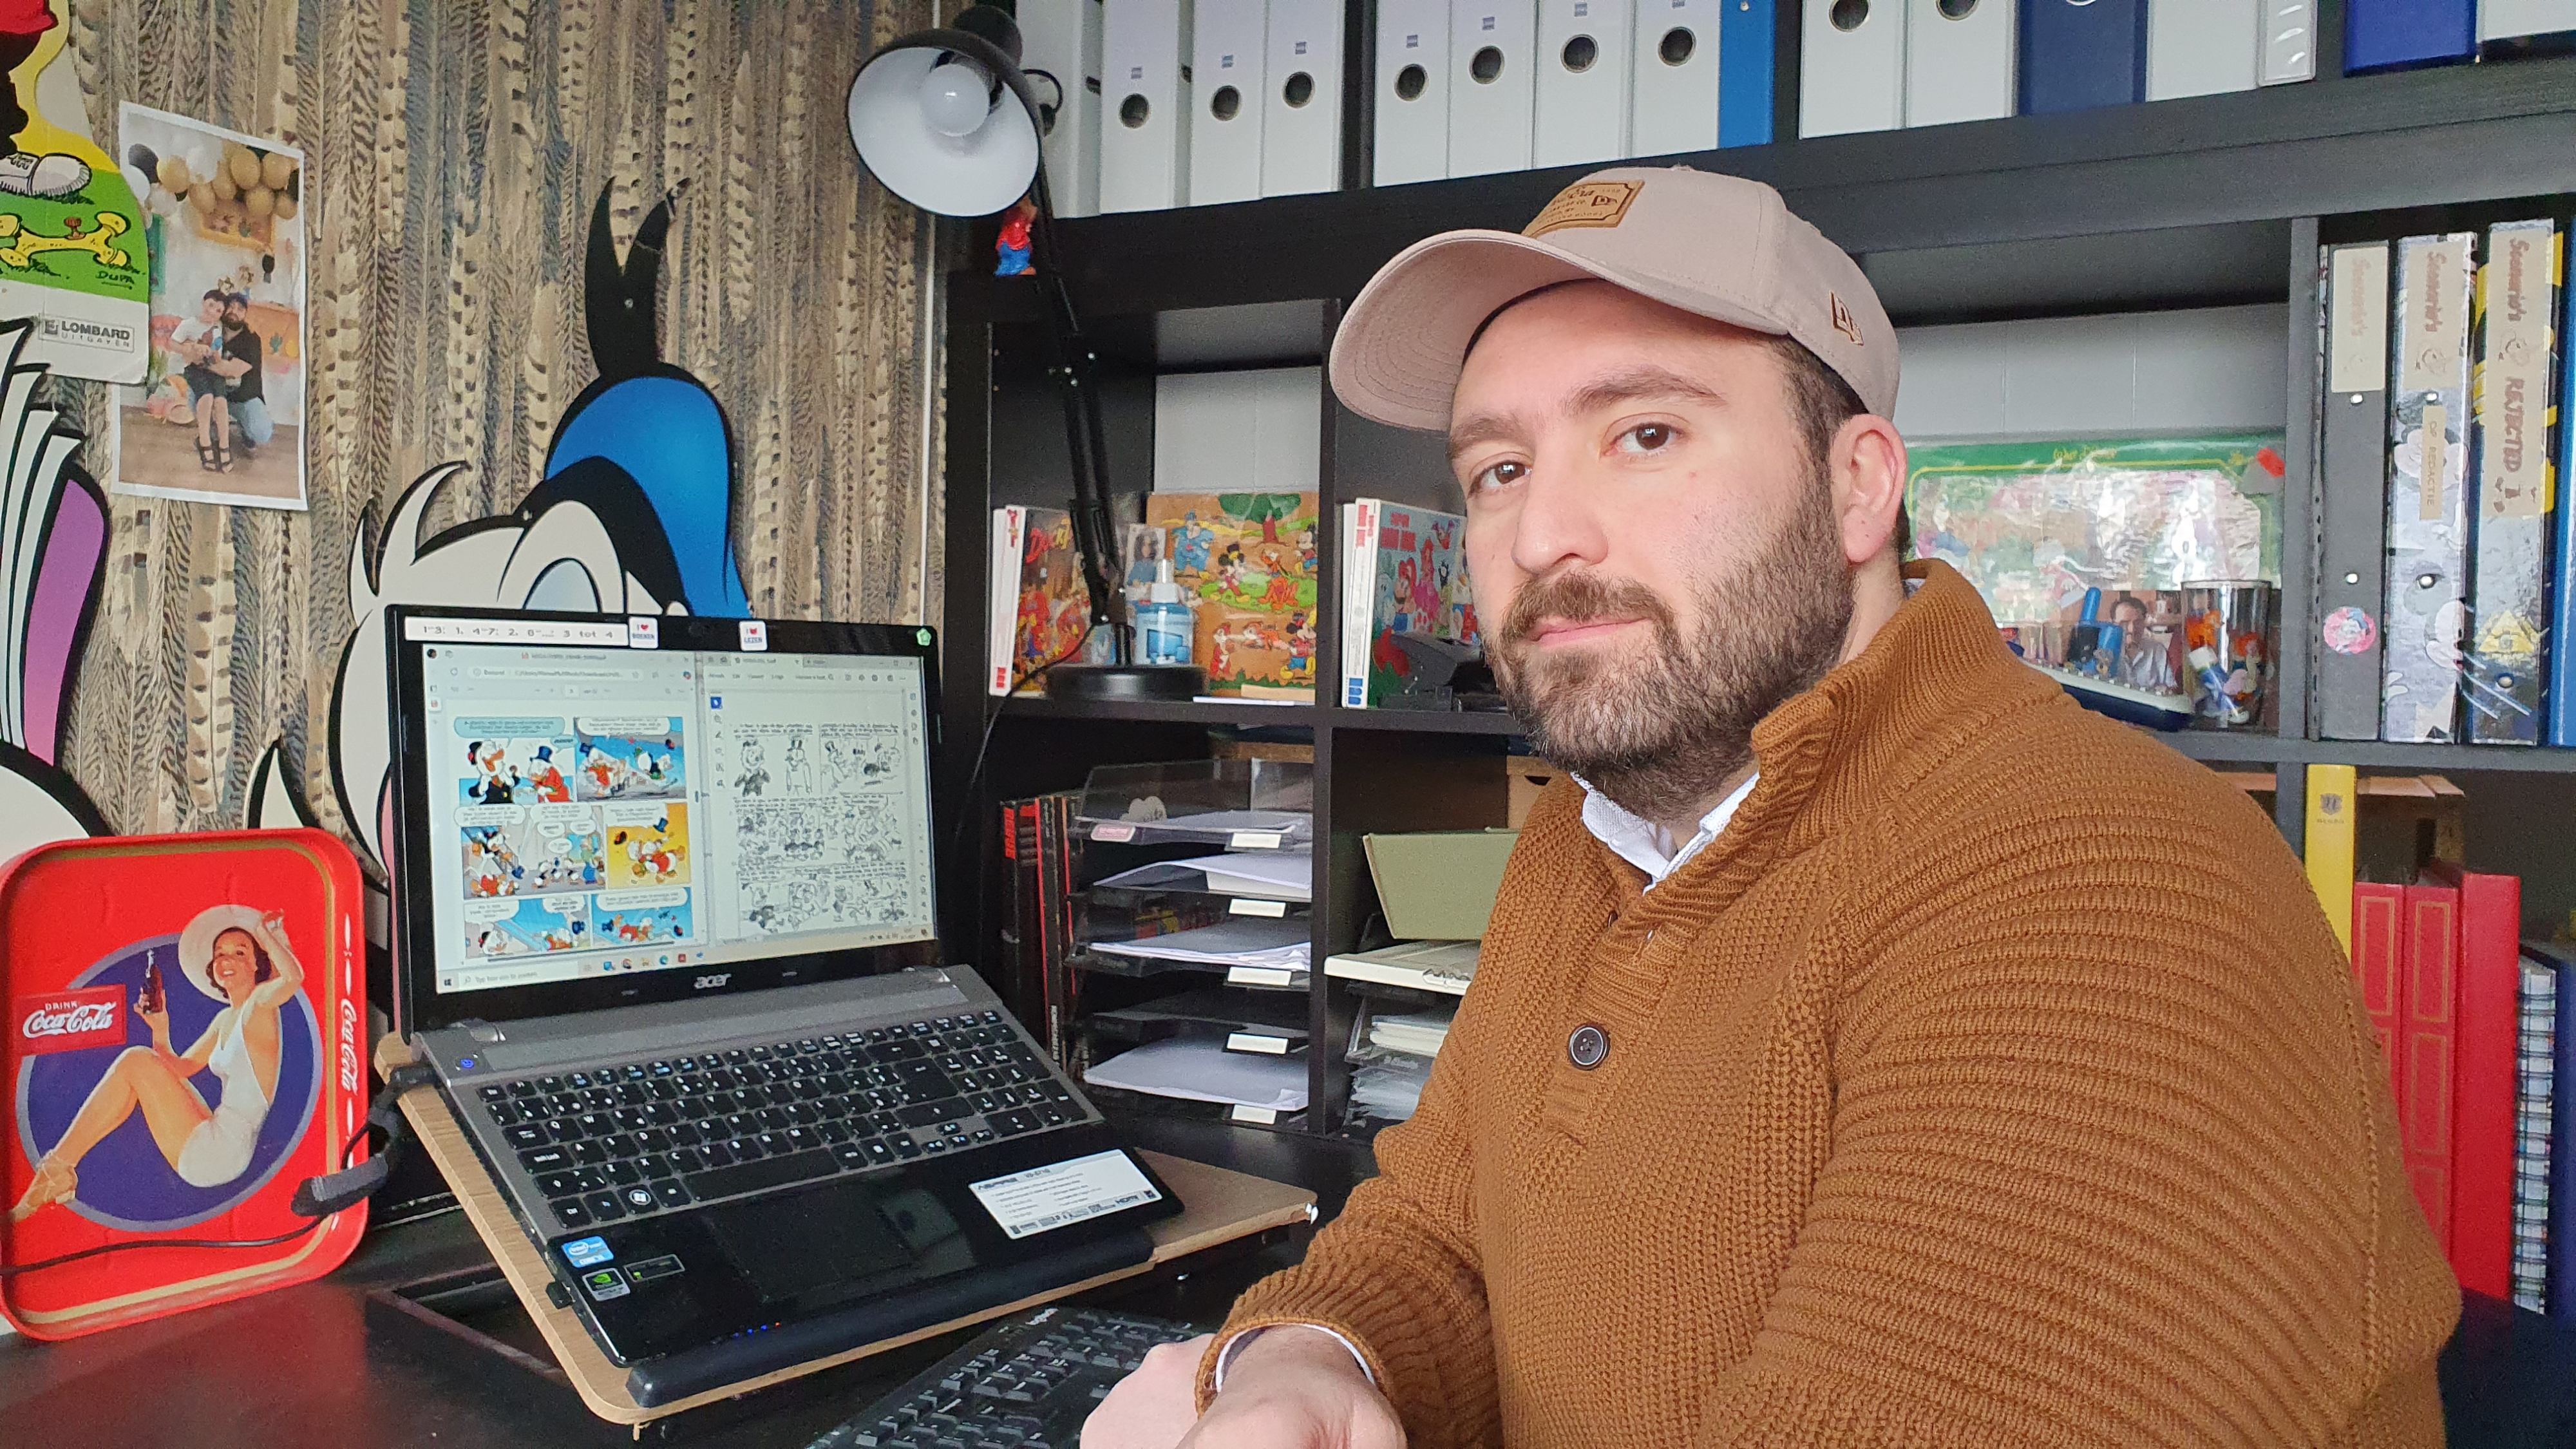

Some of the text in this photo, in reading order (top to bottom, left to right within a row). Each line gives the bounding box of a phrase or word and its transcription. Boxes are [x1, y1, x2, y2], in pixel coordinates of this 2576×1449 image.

[62, 321, 130, 340] LOMBARD
[2503, 376, 2525, 473] REJECTED
[2425, 446, 2438, 507] REDACTIE
[694, 973, 732, 989] acer
[23, 1001, 117, 1038] Coca-Cola
[44, 1001, 78, 1011] DRINK
